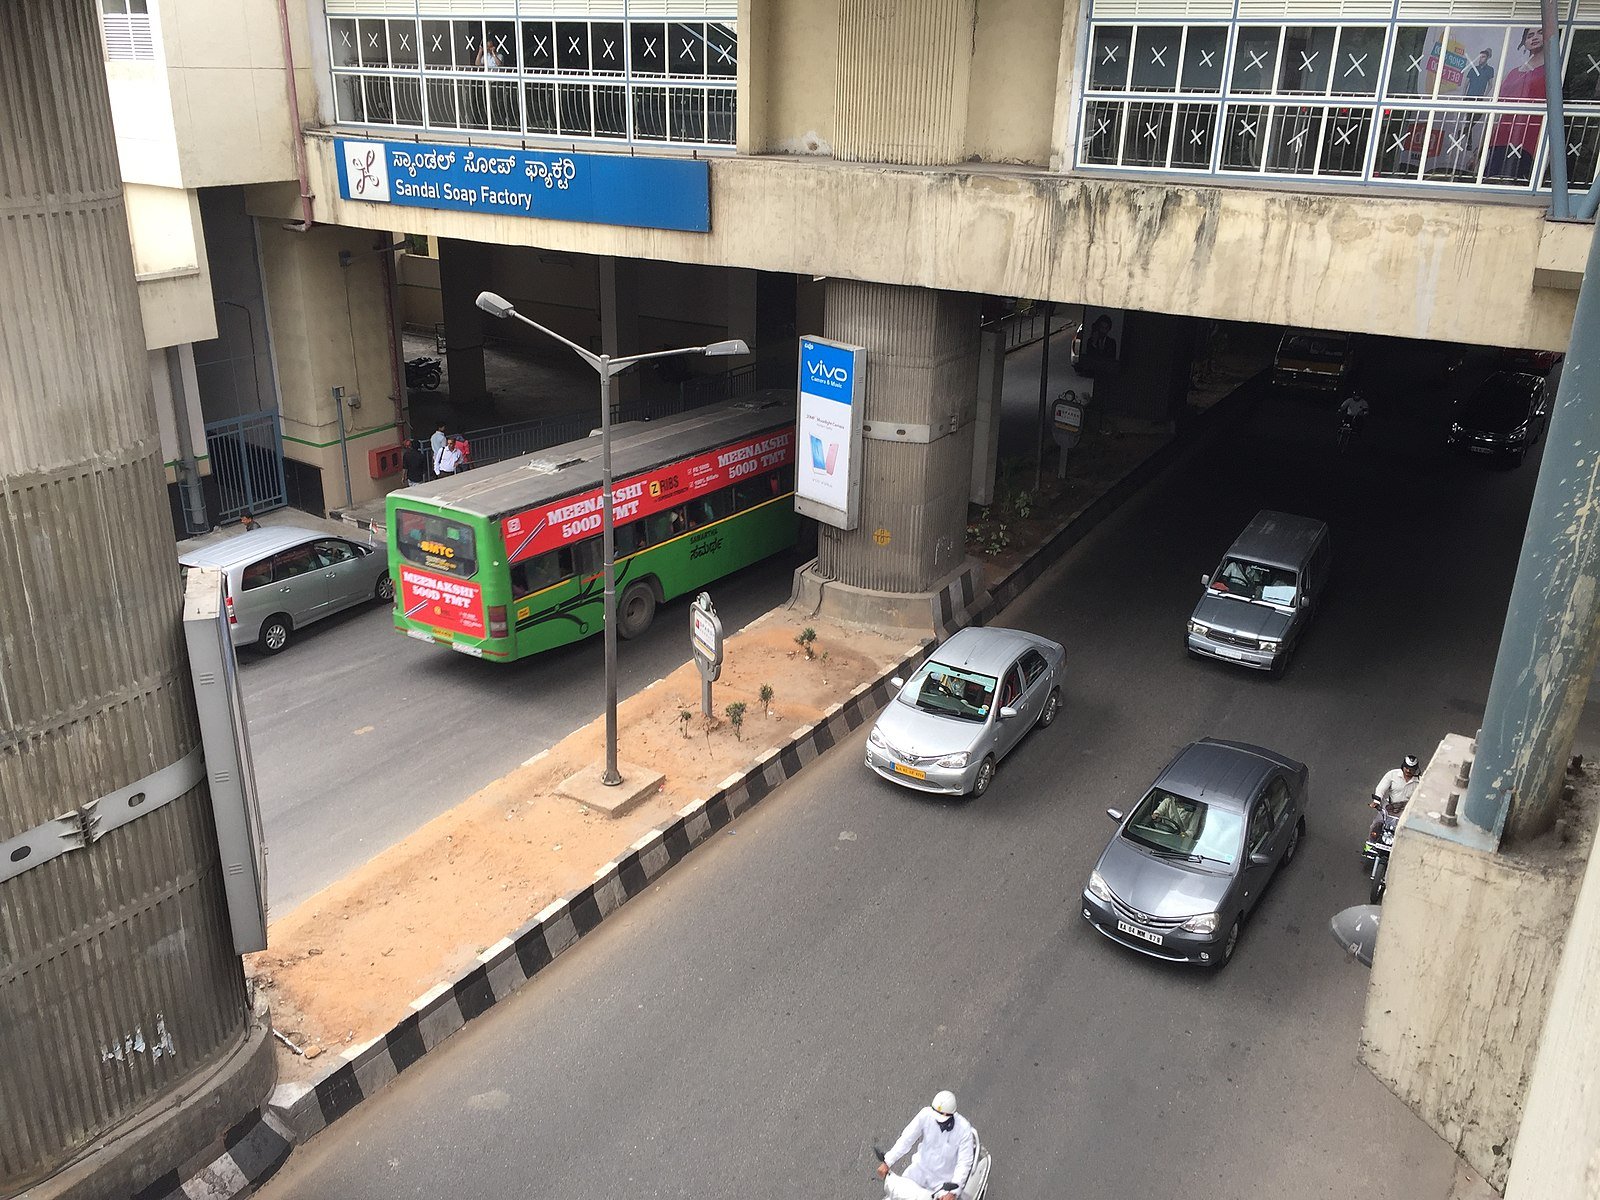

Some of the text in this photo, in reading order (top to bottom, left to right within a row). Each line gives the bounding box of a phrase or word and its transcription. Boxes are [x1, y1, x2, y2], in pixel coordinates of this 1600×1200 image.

[392, 149, 576, 190] ಸ್ಯಾಂಡಲ್ ಸೋಪ್ ಫ್ಯಾಕ್ಟರಿ
[395, 179, 532, 211] Sandal Soap Factory
[807, 359, 848, 383] vivo
[717, 434, 790, 468] MEENAKSHI
[728, 461, 758, 480] 500D
[761, 450, 787, 468] TMT
[562, 500, 640, 538] 500D MT
[420, 541, 455, 558] BMTC
[403, 571, 474, 599] MEENAKSHI
[412, 585, 472, 609] 500D TMT
